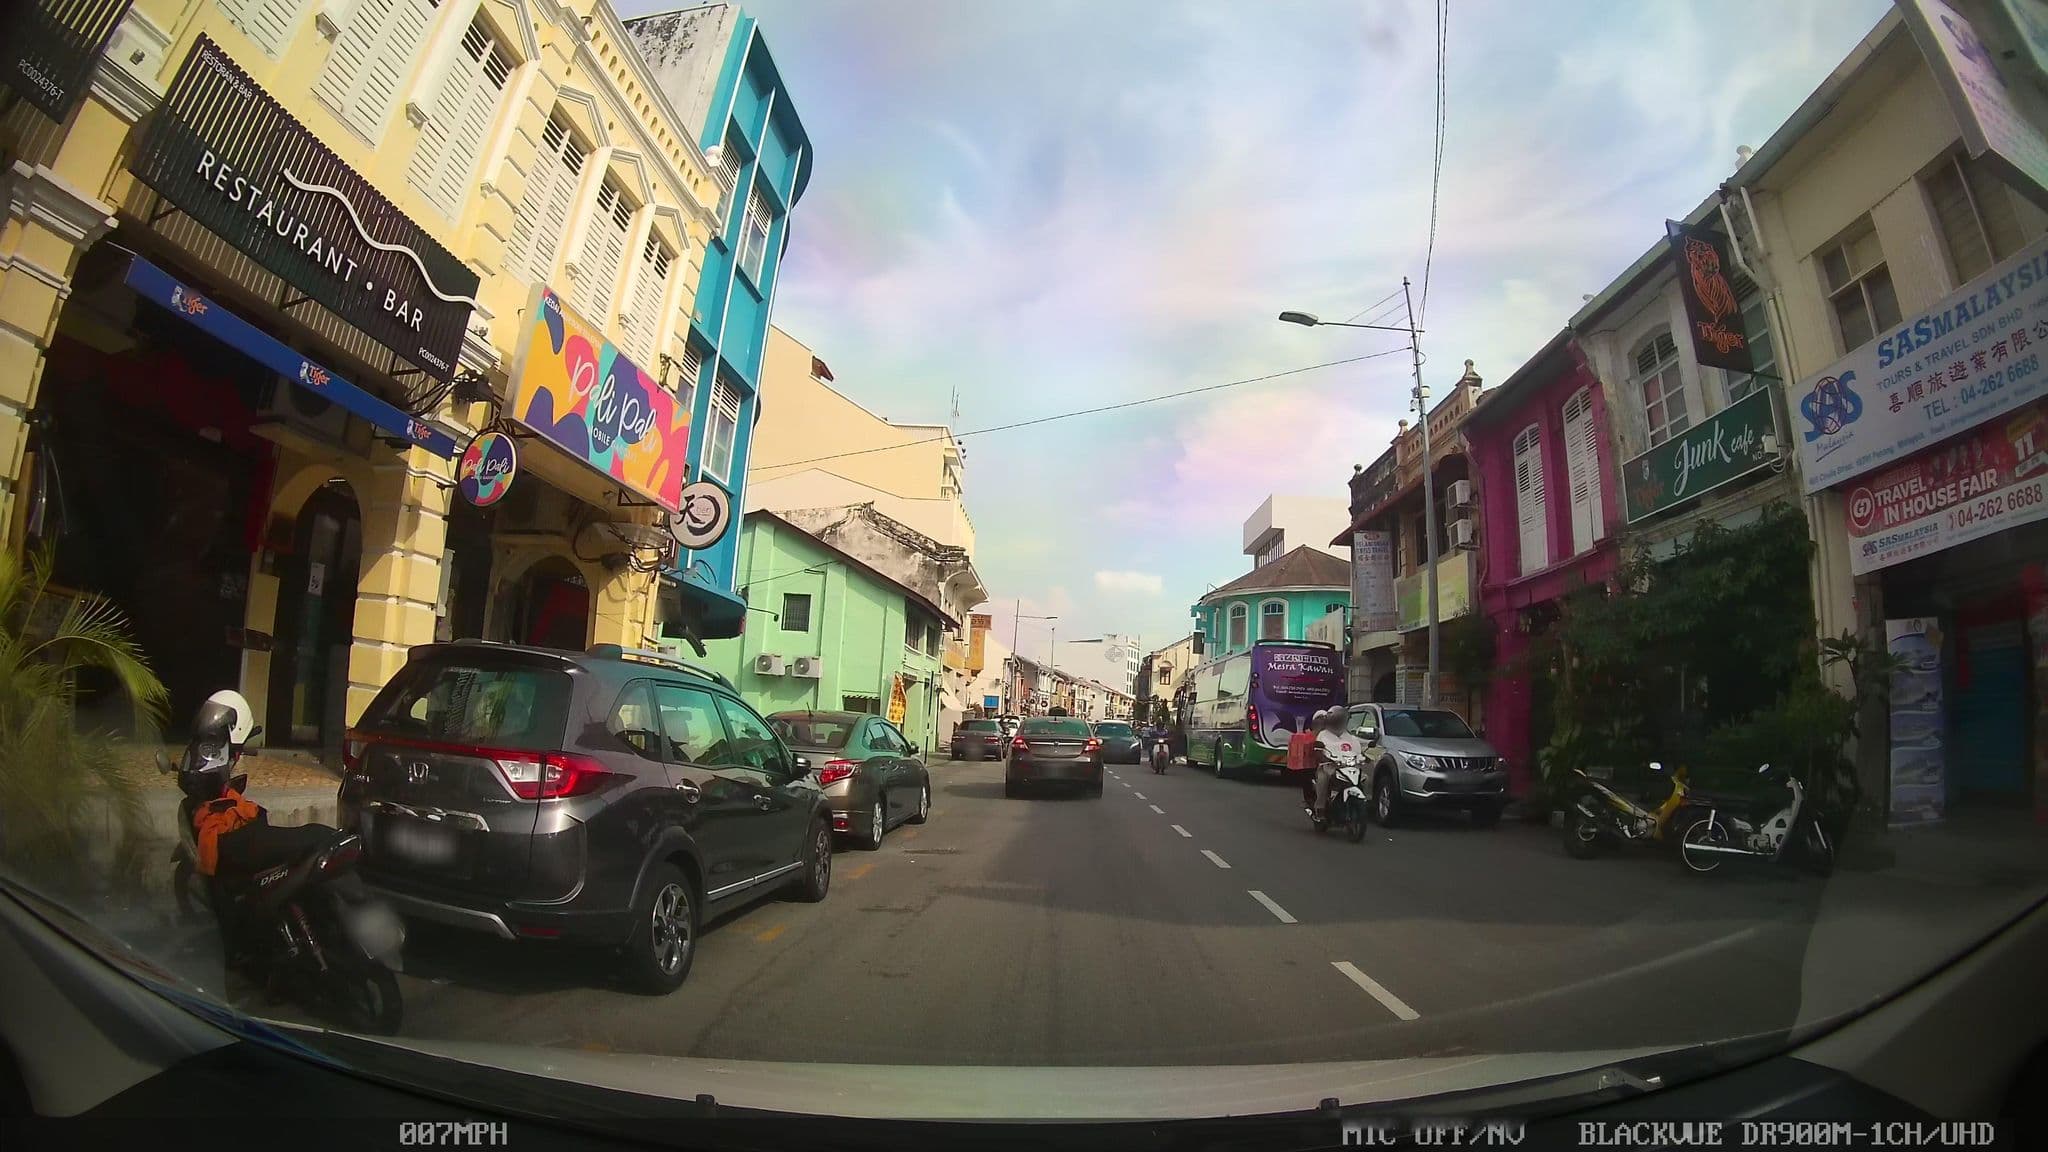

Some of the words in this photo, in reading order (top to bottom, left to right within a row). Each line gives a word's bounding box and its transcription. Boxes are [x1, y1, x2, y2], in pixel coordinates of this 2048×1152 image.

[18, 59, 64, 100] PC0024376-T
[201, 50, 235, 84] RESTORAN
[232, 81, 240, 89] &
[239, 84, 253, 101] BAR
[196, 151, 358, 283] RESTAURANT
[383, 290, 424, 332] BAR
[1697, 320, 1744, 353] Tiger
[1876, 365, 1912, 391] TOURS
[1914, 360, 1923, 373] &
[1924, 340, 1970, 366] TRAVEL
[1973, 322, 1997, 344] SDN
[1998, 307, 2023, 329] BHD
[309, 365, 330, 385] Tiger
[1961, 371, 2004, 405] 04-262
[2006, 354, 2040, 385] 6688
[414, 422, 432, 440] Tiger
[485, 457, 510, 475] Pali
[1875, 476, 1928, 507] TRAVEL
[1884, 505, 1902, 525] IN
[1902, 479, 1957, 519] HOUSE
[1961, 468, 1998, 499] FAIR
[1958, 495, 2004, 528] 04-262
[2008, 483, 2044, 509] 6688
[1267, 662, 1296, 672] Mesra
[1298, 662, 1334, 674] Kawan
